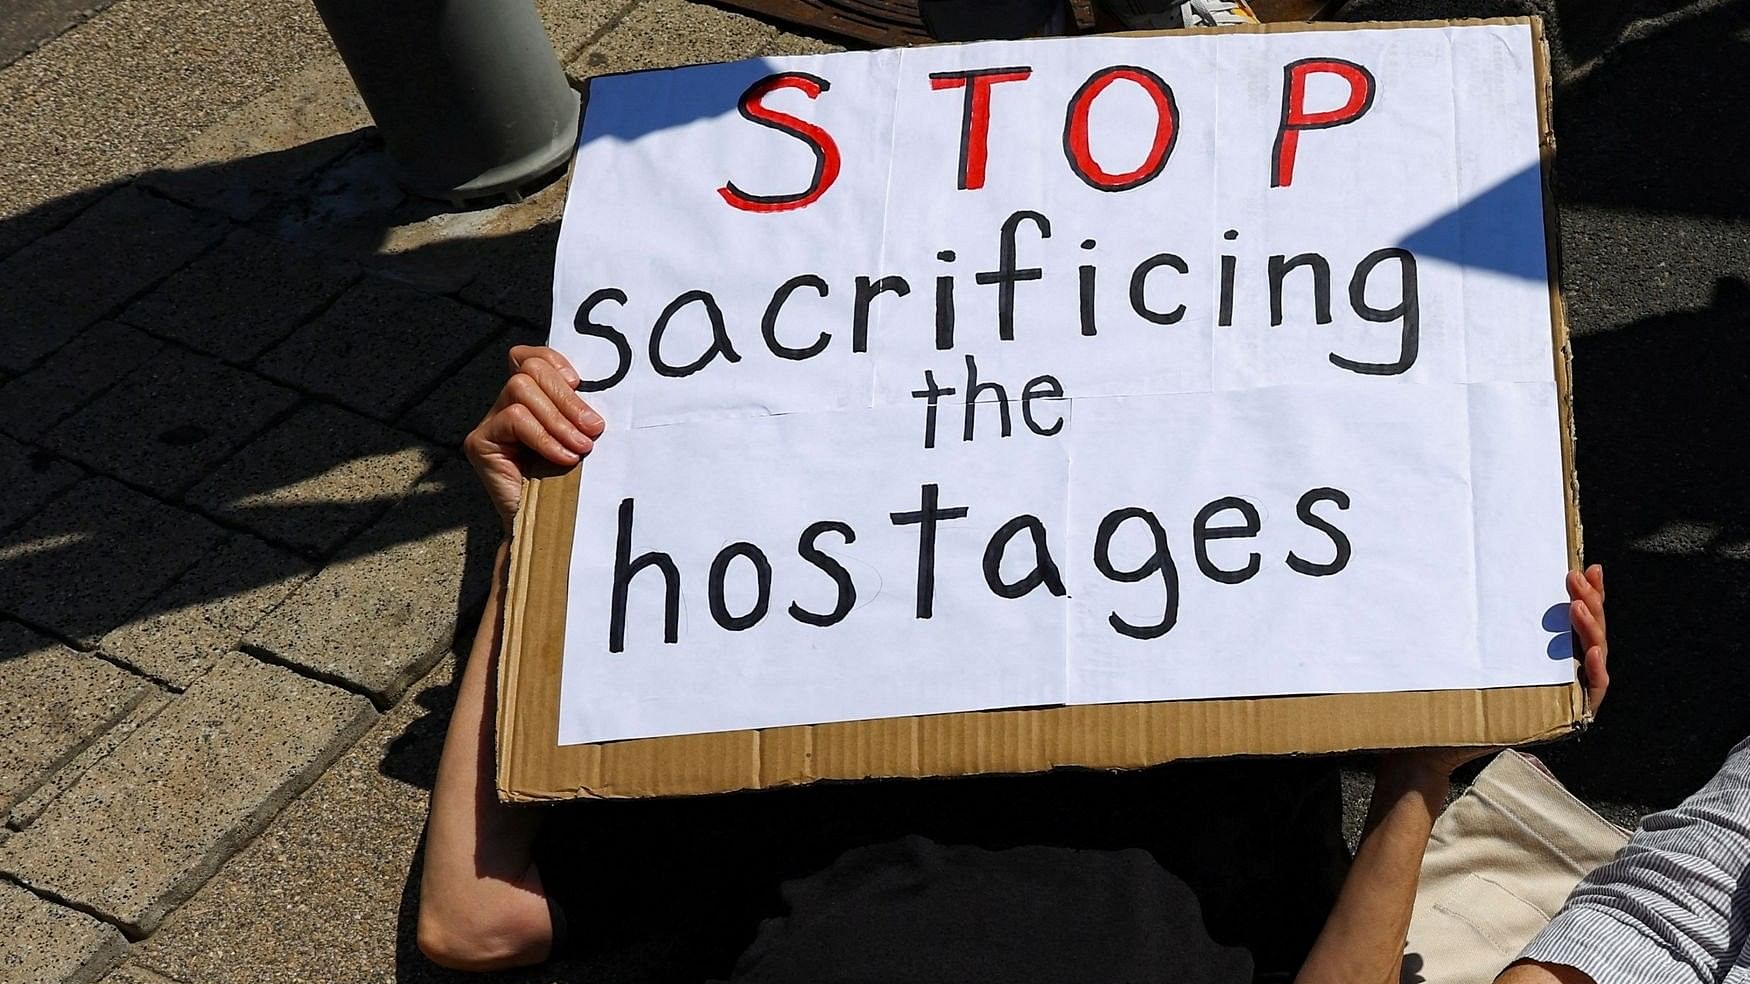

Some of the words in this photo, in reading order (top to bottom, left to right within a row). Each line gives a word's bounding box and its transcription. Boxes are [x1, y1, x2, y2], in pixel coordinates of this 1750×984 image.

[717, 57, 1376, 213] STOP
[573, 210, 1419, 392] sacrificing
[912, 355, 1065, 449] the
[610, 484, 1351, 653] hostages
